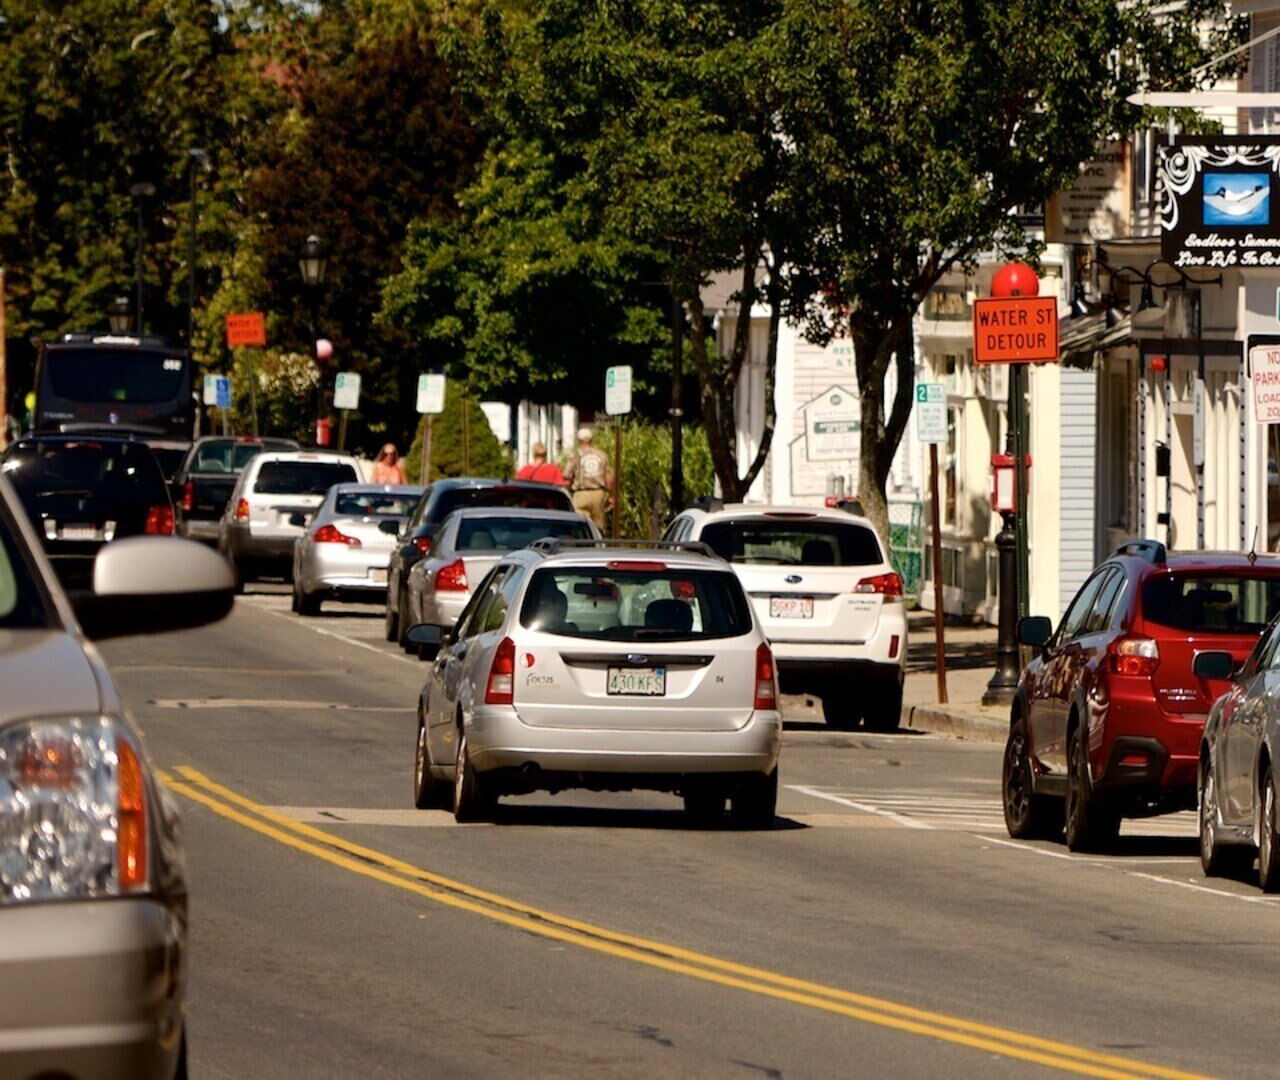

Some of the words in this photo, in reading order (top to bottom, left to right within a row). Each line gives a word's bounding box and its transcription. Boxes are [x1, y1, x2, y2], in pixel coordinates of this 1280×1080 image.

[1184, 233, 1236, 248] Endless
[1174, 250, 1206, 267] Live
[1240, 250, 1259, 265] In
[979, 309, 1028, 327] WATER
[1036, 308, 1053, 325] ST
[987, 332, 1047, 351] DETOUR
[917, 386, 927, 401] 2
